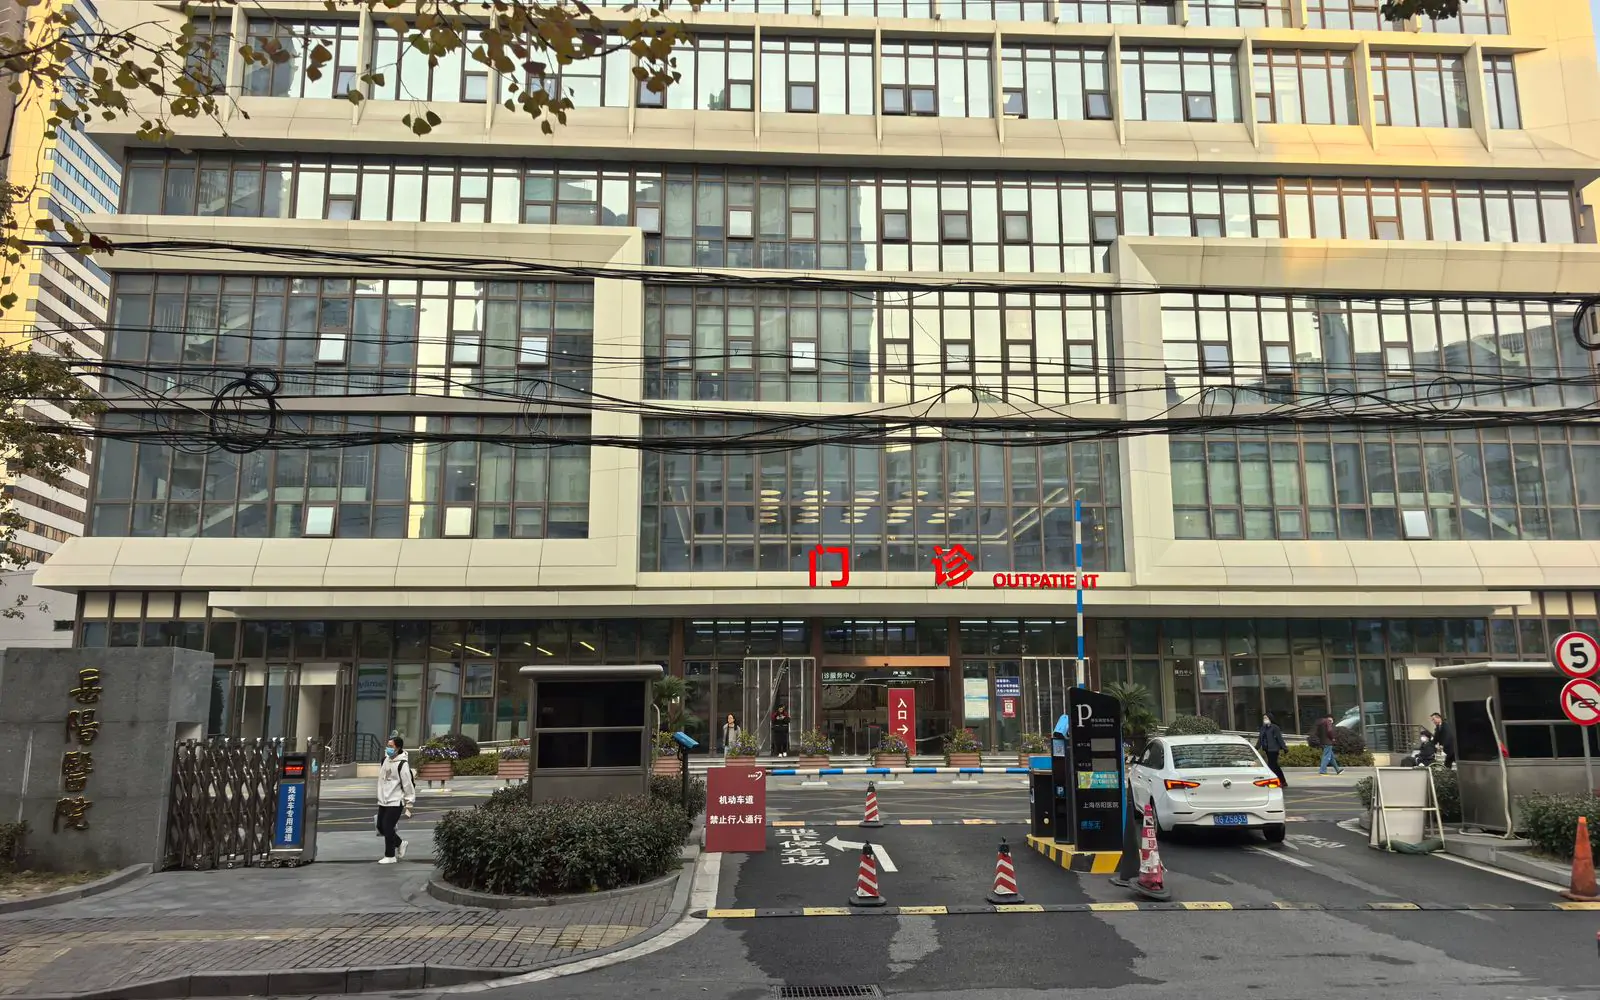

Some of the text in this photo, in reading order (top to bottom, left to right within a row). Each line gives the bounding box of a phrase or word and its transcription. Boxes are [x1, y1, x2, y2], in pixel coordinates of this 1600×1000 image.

[993, 573, 1099, 589] OUTPATIENT
[1569, 642, 1588, 669] 5
[821, 671, 857, 679] 诊服务中心
[897, 698, 907, 720] 入口
[1075, 703, 1093, 727] P
[718, 794, 755, 805] 机动车道
[1082, 801, 1120, 809] 上海岳阳医院
[284, 786, 297, 842] 残疾车专用通道
[709, 814, 763, 825] 禁止行人通行
